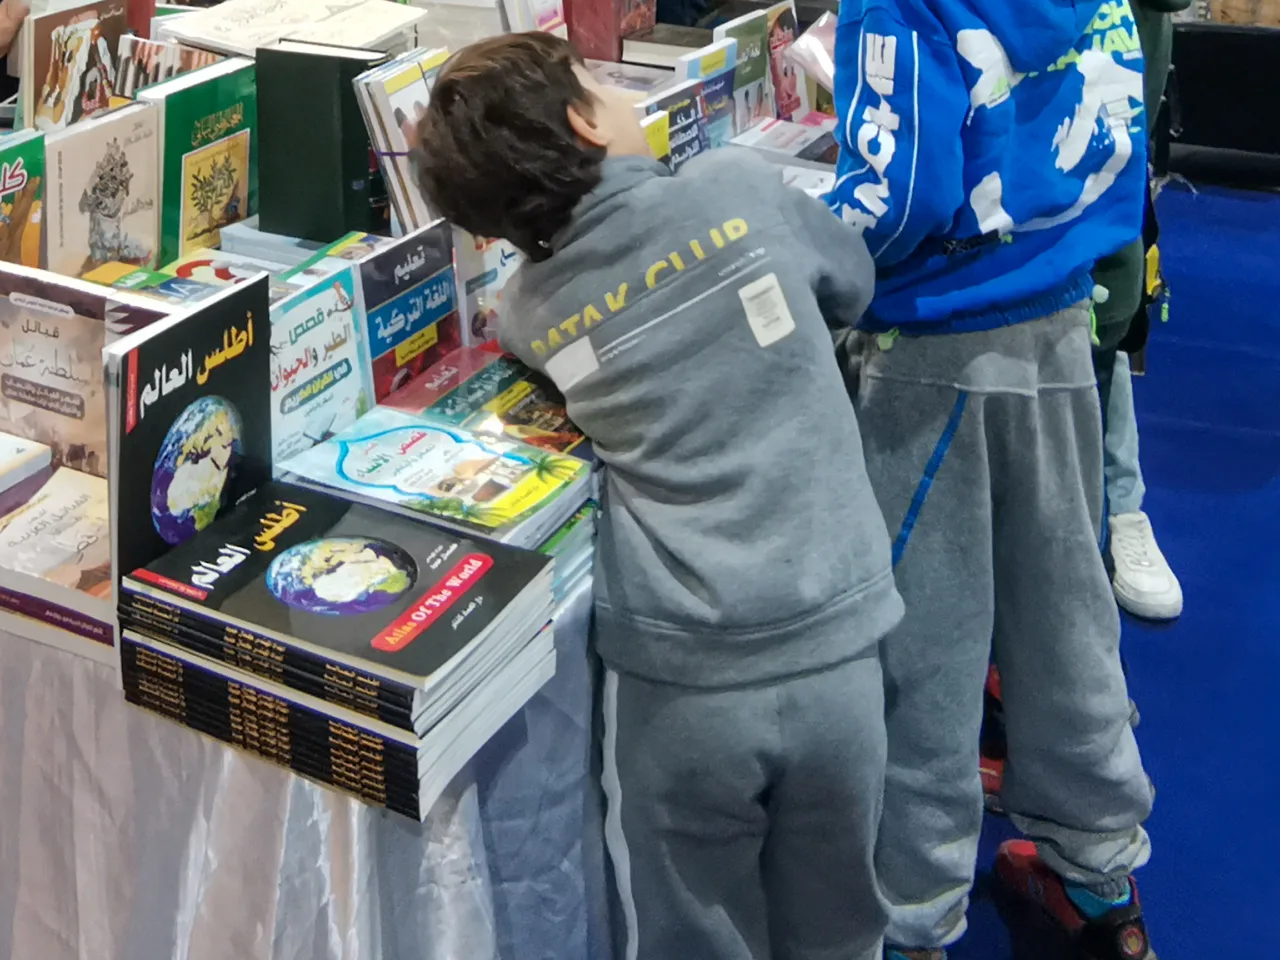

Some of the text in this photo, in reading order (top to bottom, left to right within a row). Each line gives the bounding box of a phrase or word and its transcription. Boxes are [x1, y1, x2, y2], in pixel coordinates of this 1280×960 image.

[392, 244, 426, 285] تعليم
[376, 280, 451, 341] اللغة التركية
[139, 348, 193, 420] العالم
[186, 310, 254, 386] أطلس
[189, 499, 308, 591] أطلس العالم
[383, 558, 483, 646] Atlas Of The World
